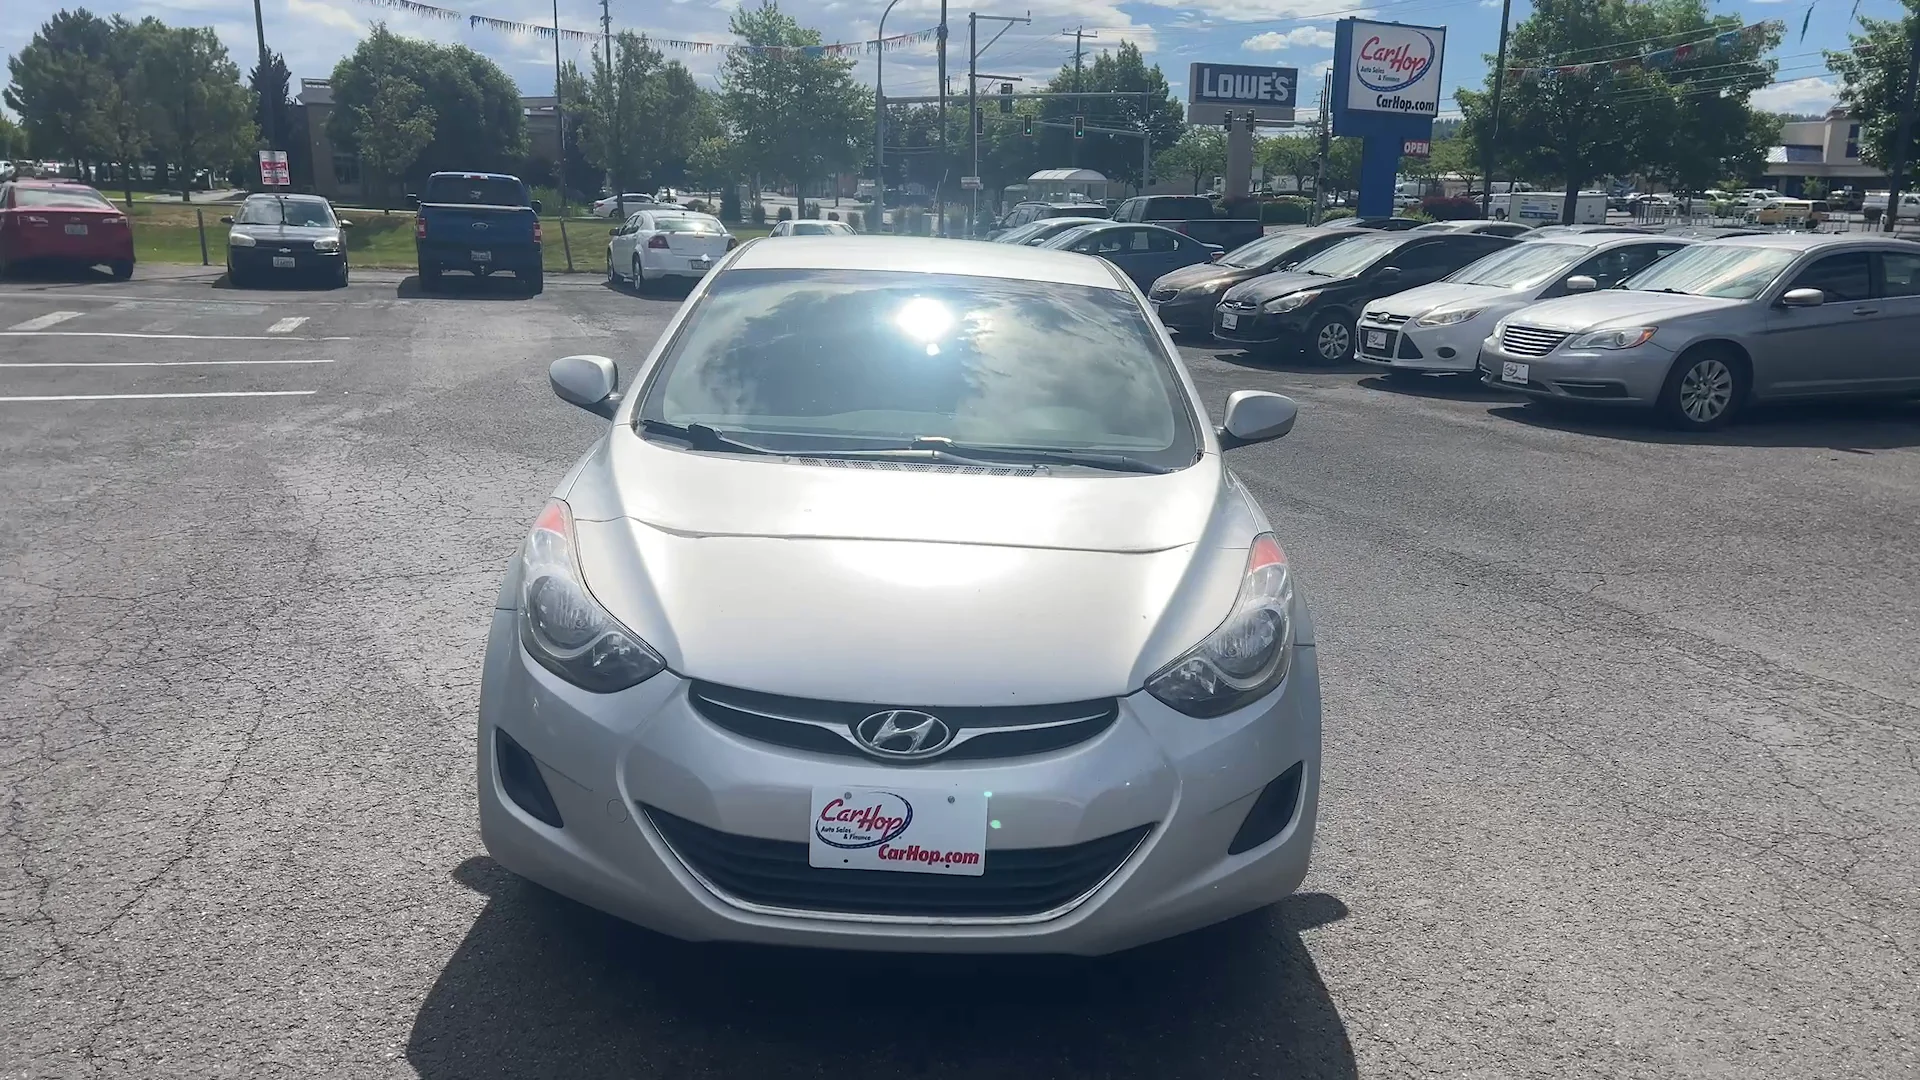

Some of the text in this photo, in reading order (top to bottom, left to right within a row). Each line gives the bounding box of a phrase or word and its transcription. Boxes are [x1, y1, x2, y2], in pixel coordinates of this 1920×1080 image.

[1361, 36, 1426, 81] CarHop
[1202, 68, 1289, 101] LOWE'S
[1376, 94, 1435, 112] CarHop.com
[1403, 141, 1429, 154] OPEN
[820, 798, 903, 840] CarHop
[820, 825, 852, 834] Auto Sales
[849, 833, 871, 841] Finance
[878, 843, 979, 865] CarHop.com
